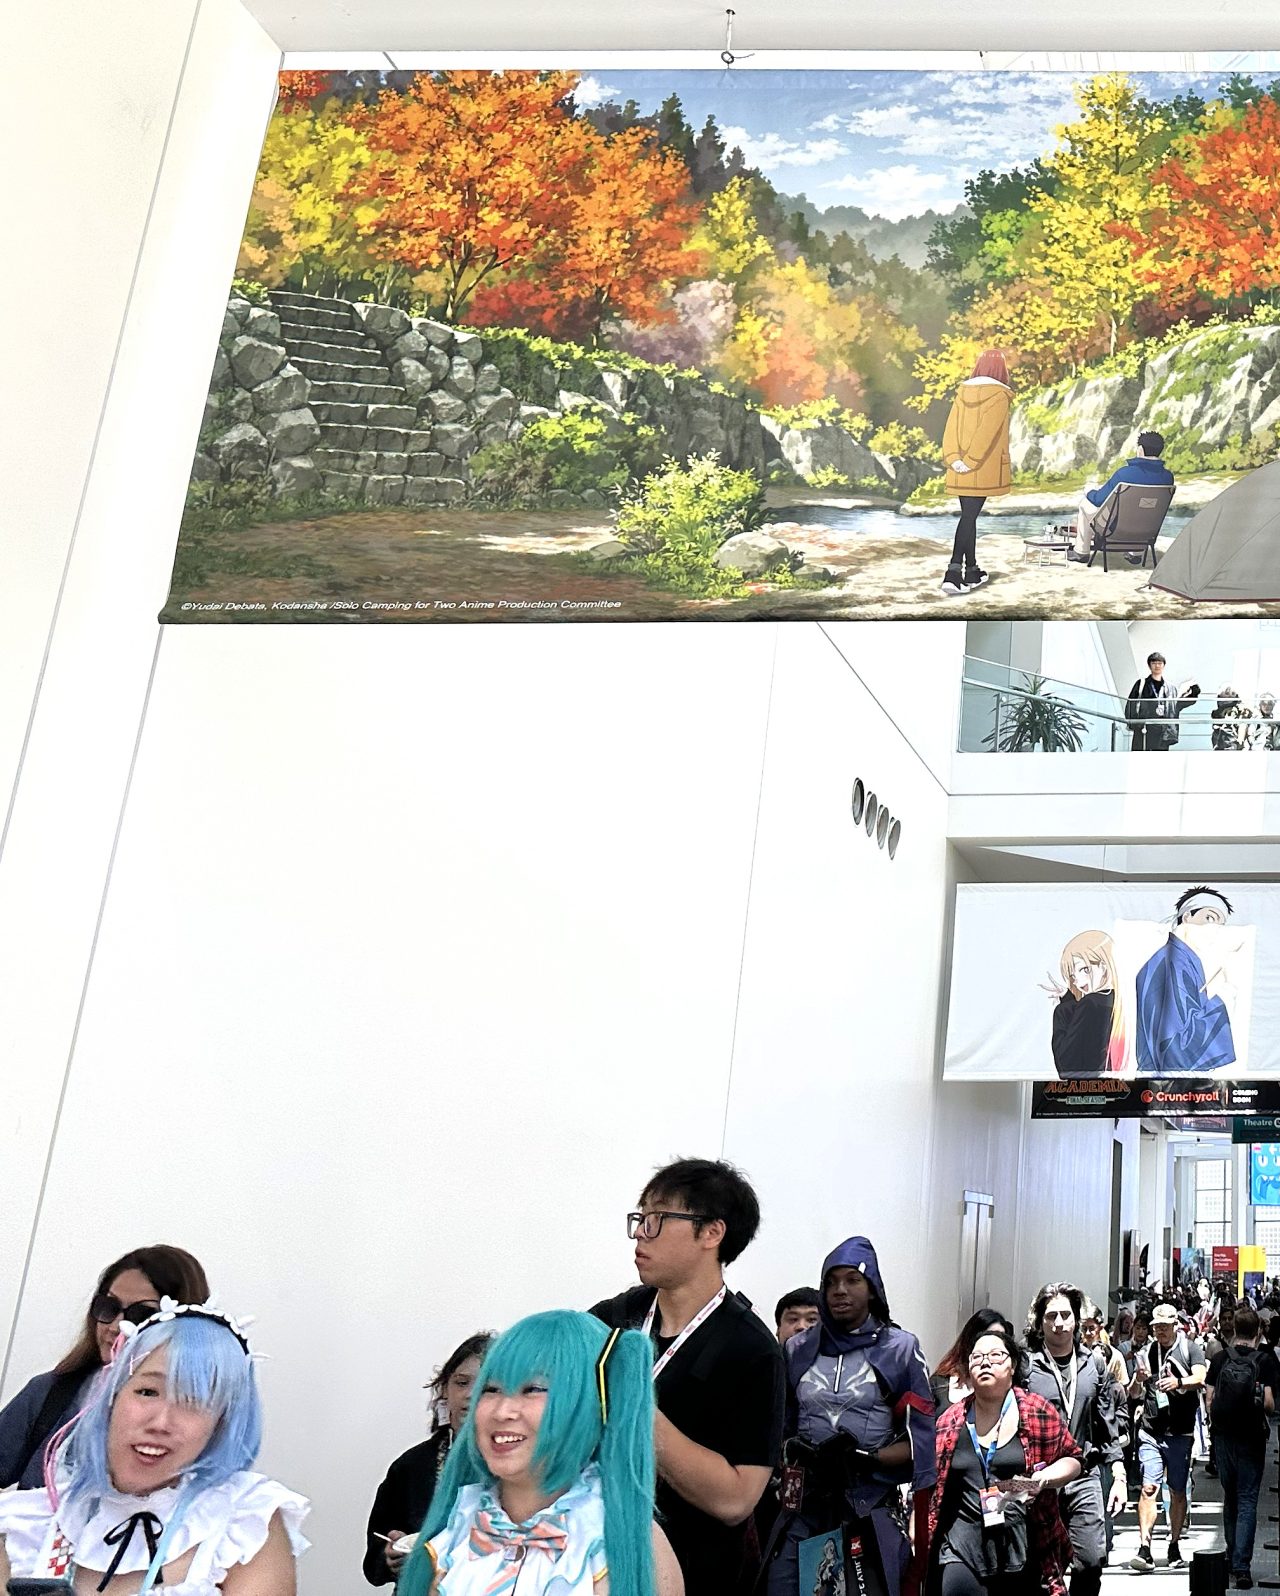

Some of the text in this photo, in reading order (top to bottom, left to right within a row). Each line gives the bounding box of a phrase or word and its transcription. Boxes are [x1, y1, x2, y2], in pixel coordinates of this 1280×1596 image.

[271, 601, 328, 611] Kodansha
[361, 601, 412, 611] Camping
[414, 600, 431, 609] for
[433, 600, 457, 609] Two
[458, 600, 496, 609] Anime
[497, 600, 559, 609] Production
[560, 600, 622, 609] Committee
[1155, 1091, 1220, 1105] Crunchyroll
[1243, 1118, 1273, 1127] Theatre
